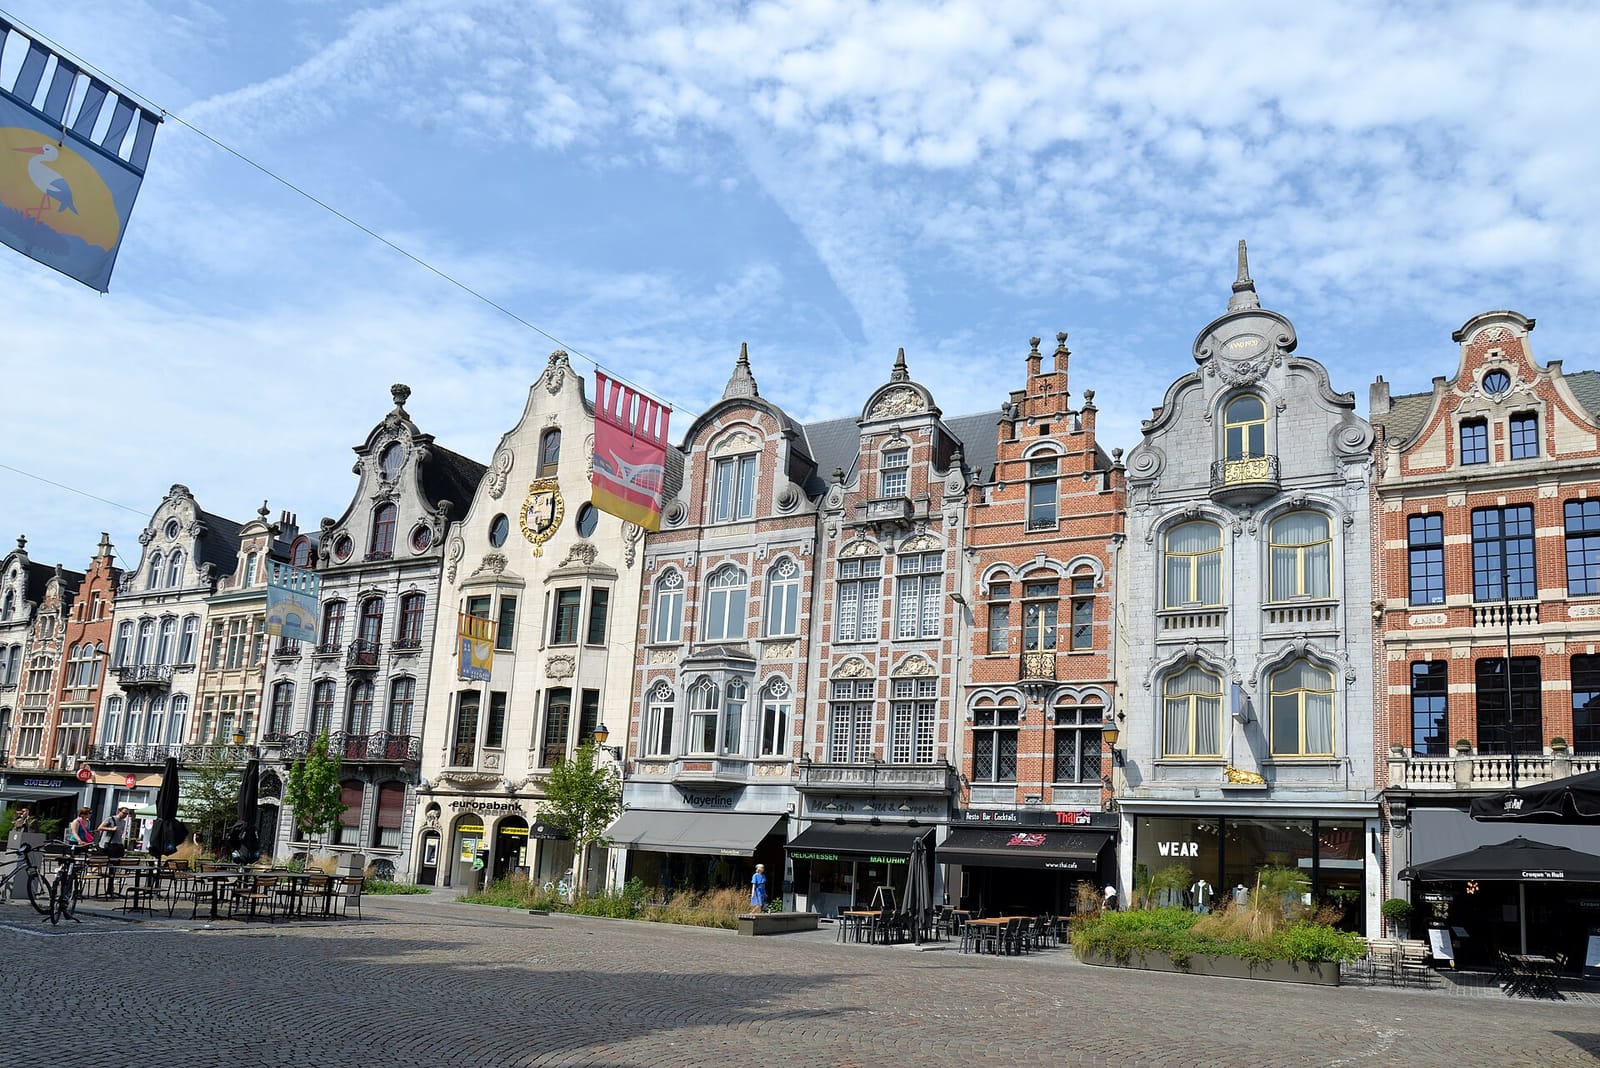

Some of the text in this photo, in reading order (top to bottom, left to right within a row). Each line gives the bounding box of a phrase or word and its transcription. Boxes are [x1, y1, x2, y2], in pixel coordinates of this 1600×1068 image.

[1413, 616, 1443, 625] ANNO
[452, 800, 522, 811] europabank
[683, 794, 732, 807] Mayerline
[965, 811, 1016, 821] Resto Bar Cocktails
[1158, 842, 1198, 857] WEAR
[790, 852, 838, 861] DELICATESSEN
[870, 856, 905, 864] MATURIN
